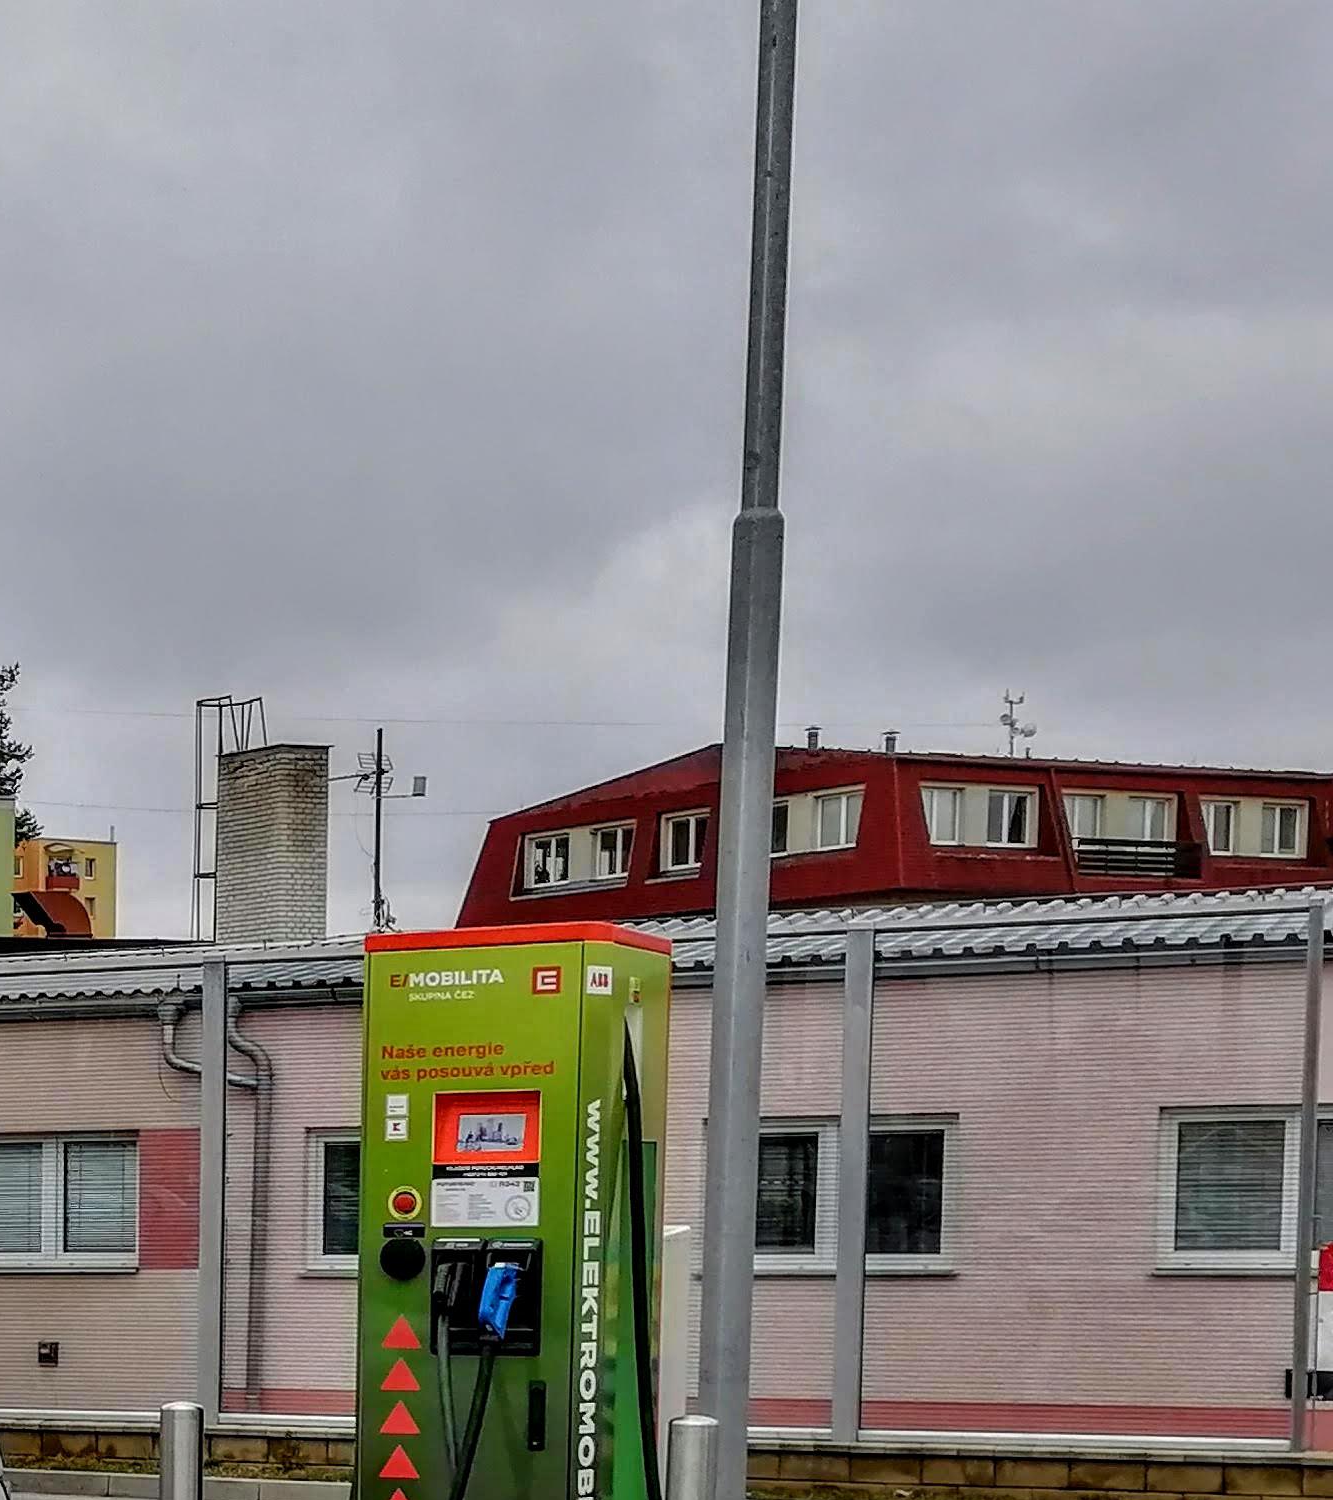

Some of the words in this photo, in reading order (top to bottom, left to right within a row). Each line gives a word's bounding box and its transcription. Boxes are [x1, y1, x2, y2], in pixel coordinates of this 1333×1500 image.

[589, 972, 609, 988] ABB
[408, 991, 452, 1002] SKUPINA
[454, 989, 475, 1001] ČEZ
[381, 1043, 427, 1060] Naše
[432, 1042, 505, 1059] energie
[380, 1065, 411, 1081] vás
[416, 1062, 495, 1082] posouvá
[499, 1059, 555, 1079] vpřed
